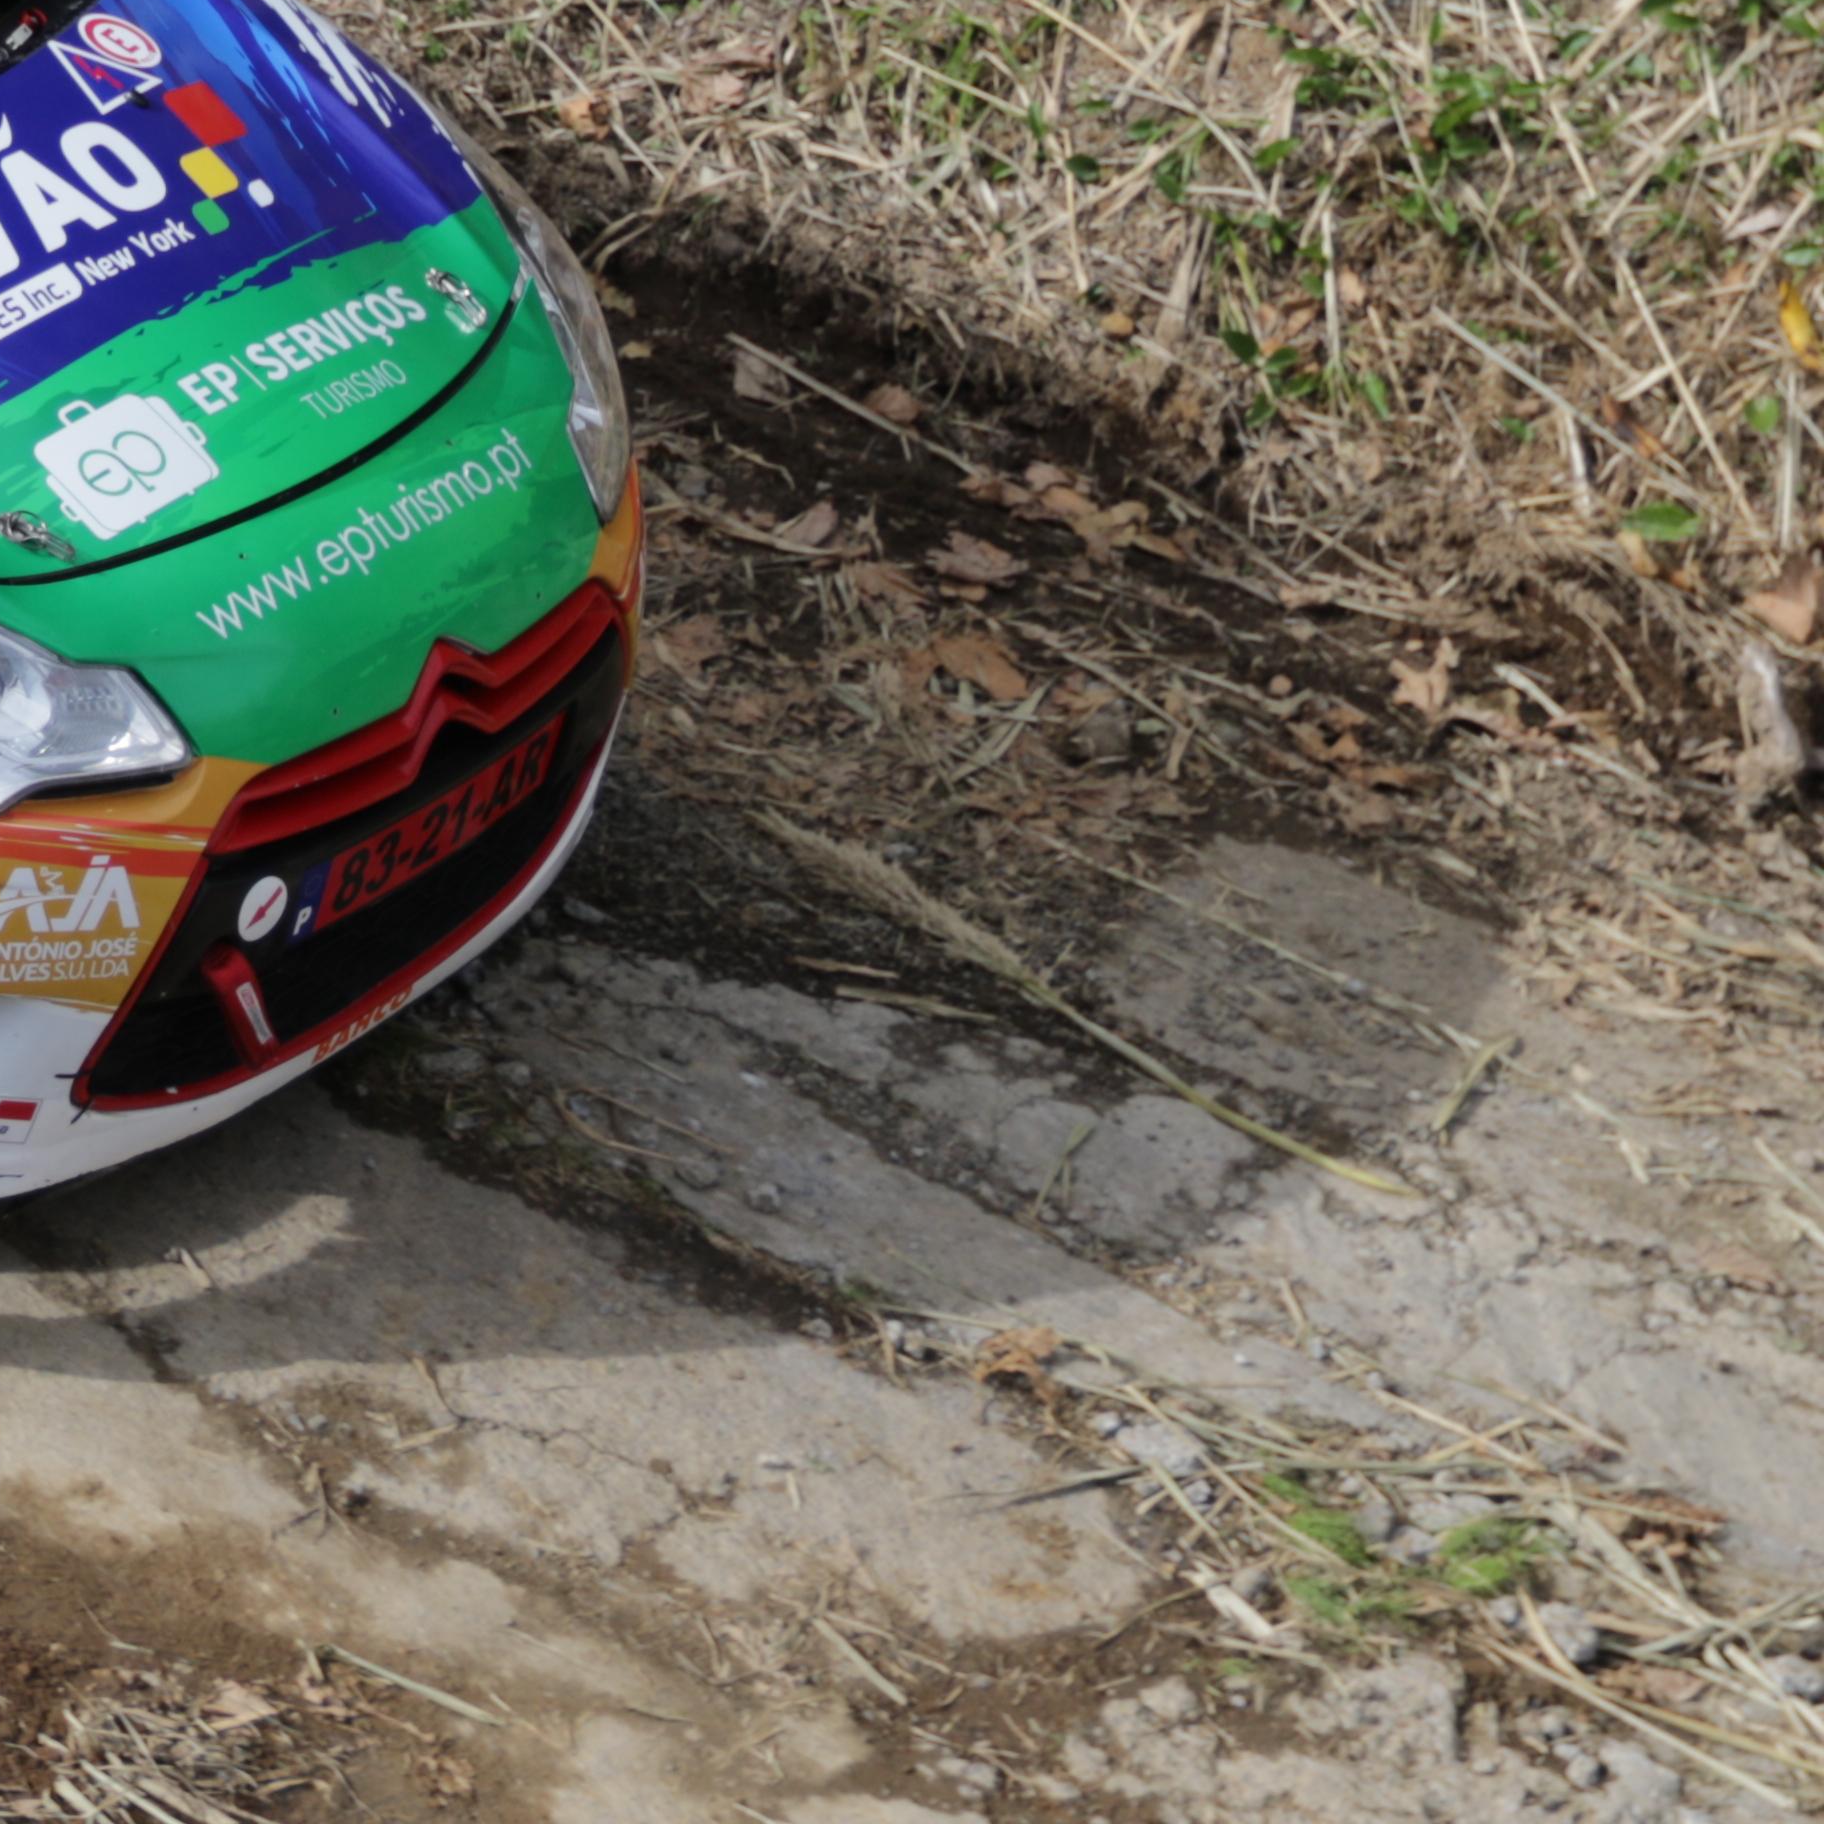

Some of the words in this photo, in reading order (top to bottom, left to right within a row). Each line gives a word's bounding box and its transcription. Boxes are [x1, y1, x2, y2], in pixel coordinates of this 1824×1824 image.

[21, 276, 71, 313] Inc.
[74, 245, 136, 286] New
[127, 217, 196, 261] York
[177, 361, 240, 415] EP
[245, 285, 428, 382] SERVIÇOS
[300, 359, 407, 420] TURISMO
[196, 427, 533, 640] www.epturismo.pt
[85, 932, 138, 959] JOSÉ
[293, 906, 312, 936] P
[90, 959, 129, 978] LDA
